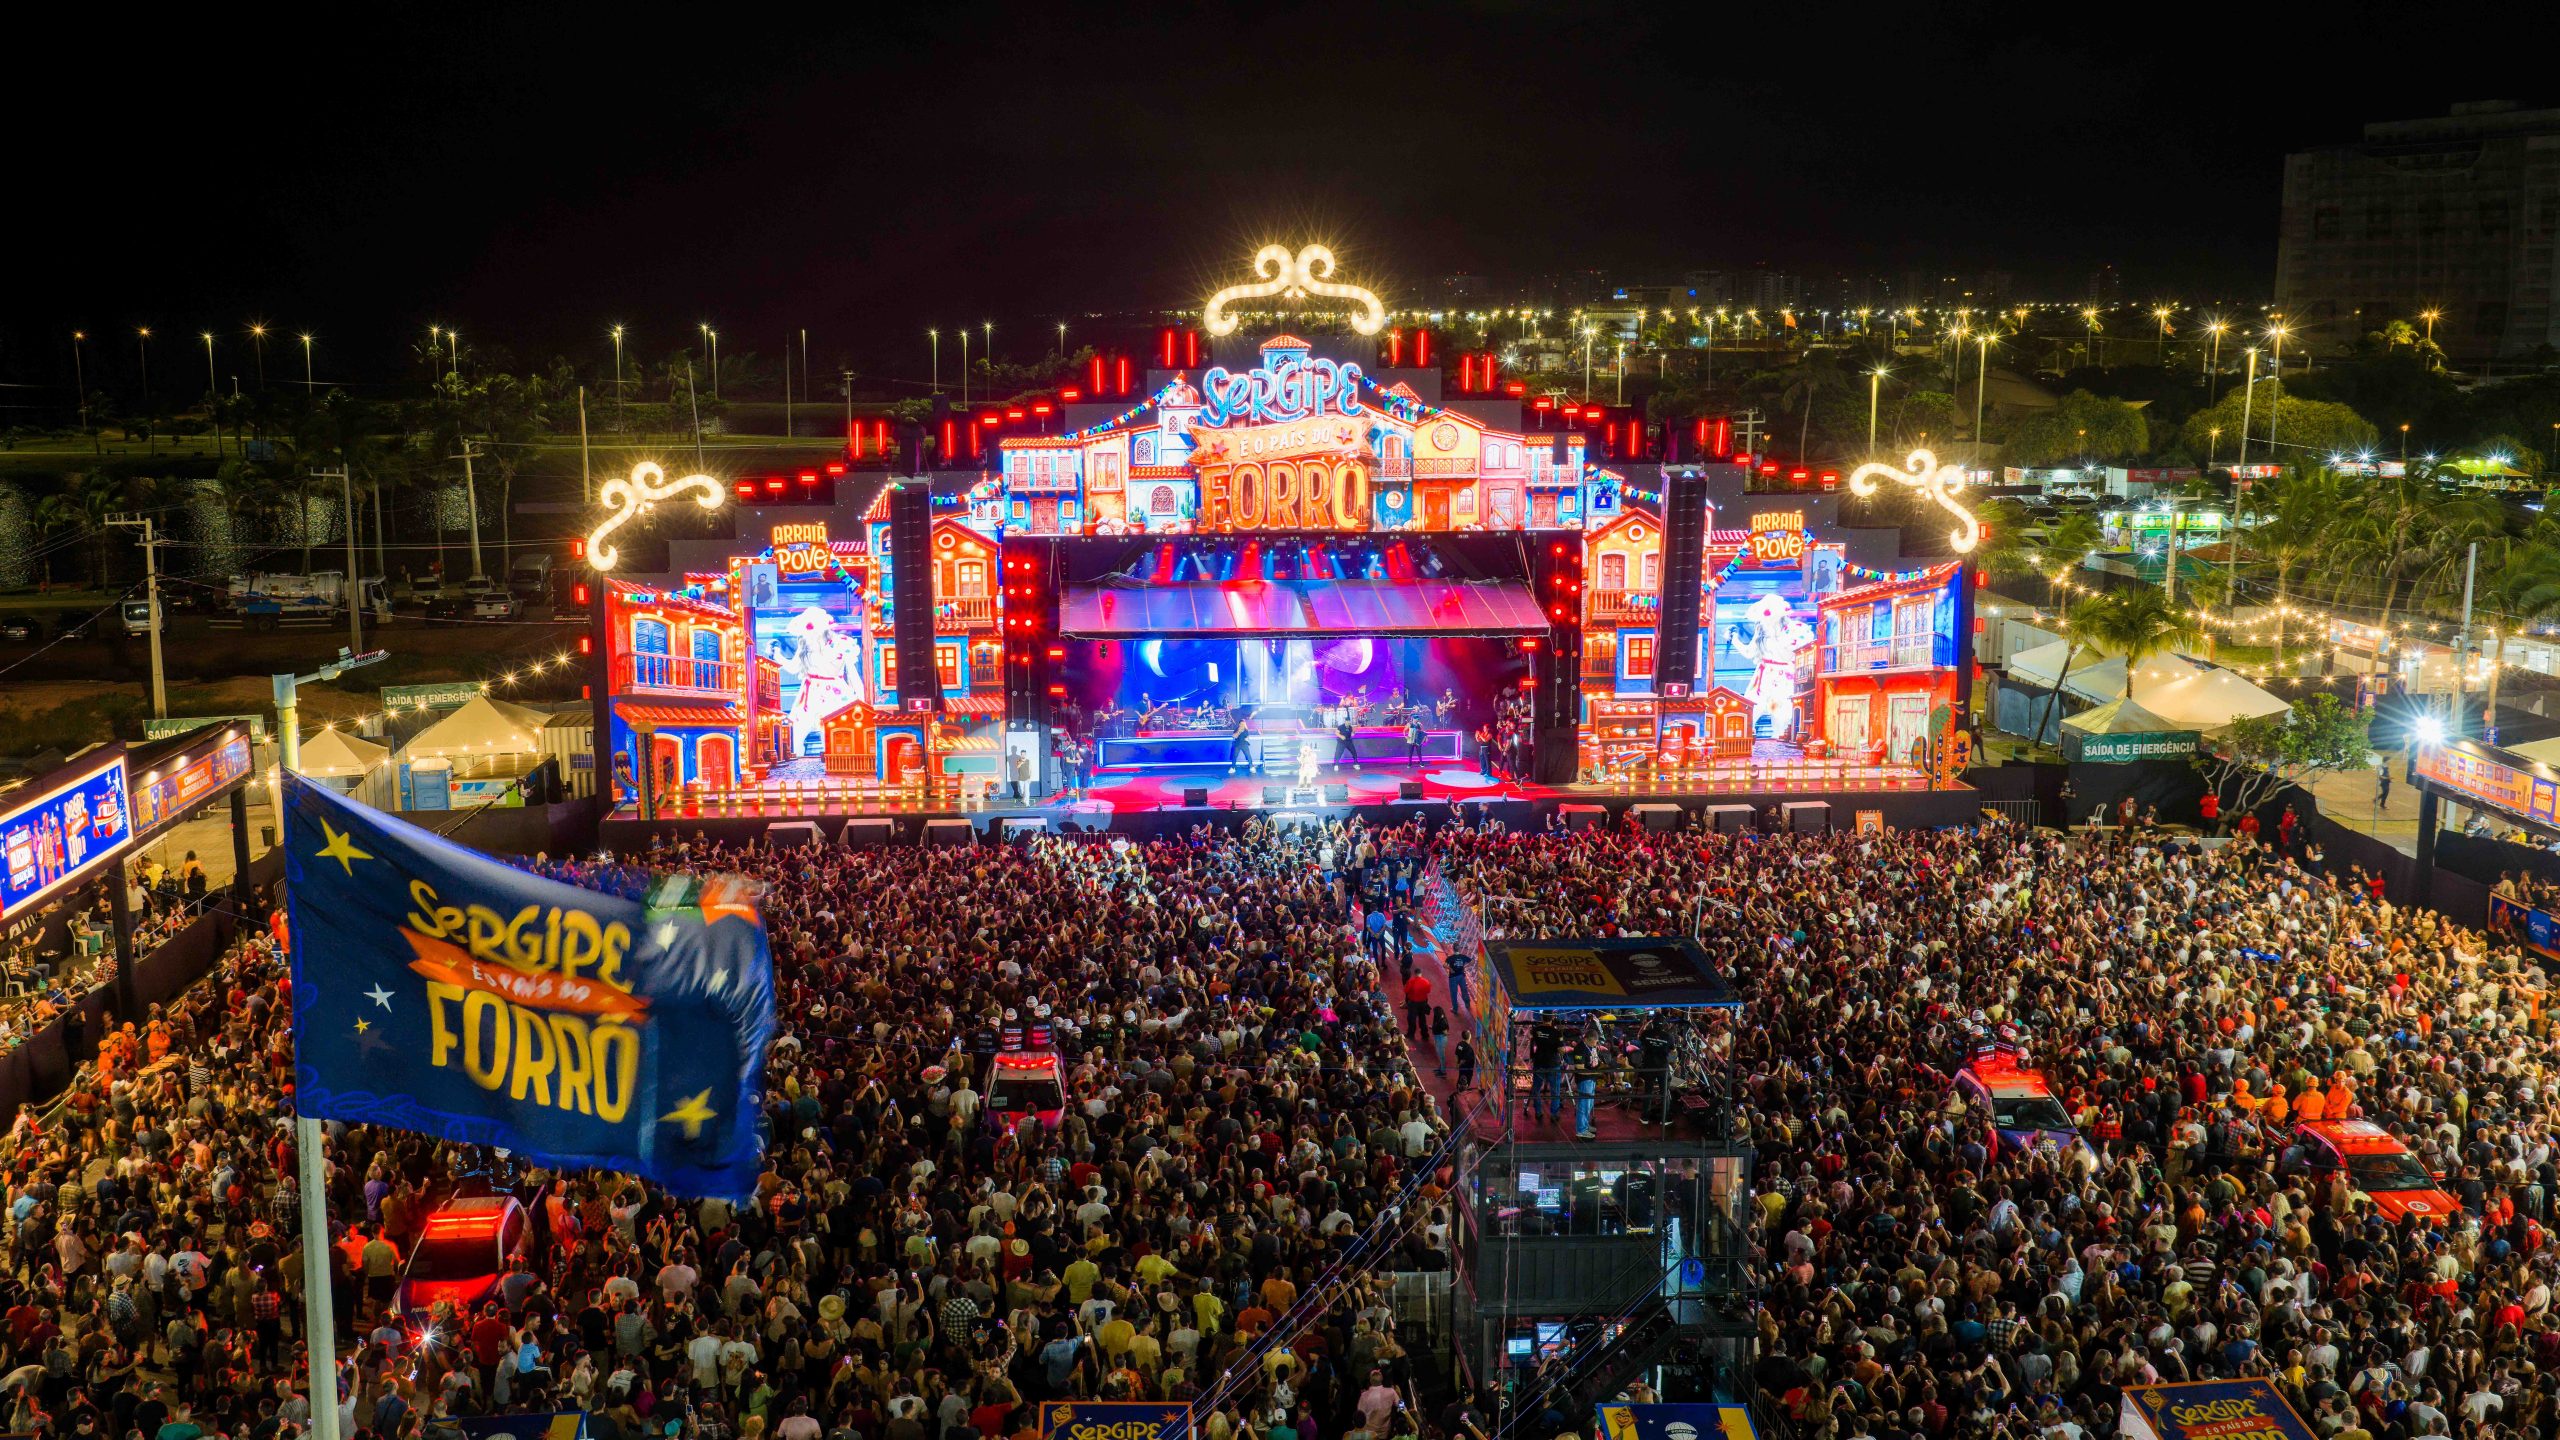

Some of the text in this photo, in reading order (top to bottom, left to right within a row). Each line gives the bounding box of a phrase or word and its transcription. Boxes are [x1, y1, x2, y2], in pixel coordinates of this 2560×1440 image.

[1254, 437, 1264, 454] O
[1269, 427, 1306, 451] PAÍS
[1312, 428, 1331, 444] DO
[1752, 510, 1803, 533] ARRAIÁ
[773, 521, 827, 545] ARRAIÁ
[385, 694, 413, 706] SAÍDA
[414, 695, 427, 705] DE
[2084, 741, 2197, 756] SAÍDA DE EMERGÊNCIA
[1631, 974, 1696, 987] SERGIPE
[427, 981, 640, 1123] FORRÓ
[2220, 1421, 2241, 1431] PAÍS
[2243, 1420, 2255, 1428] DO
